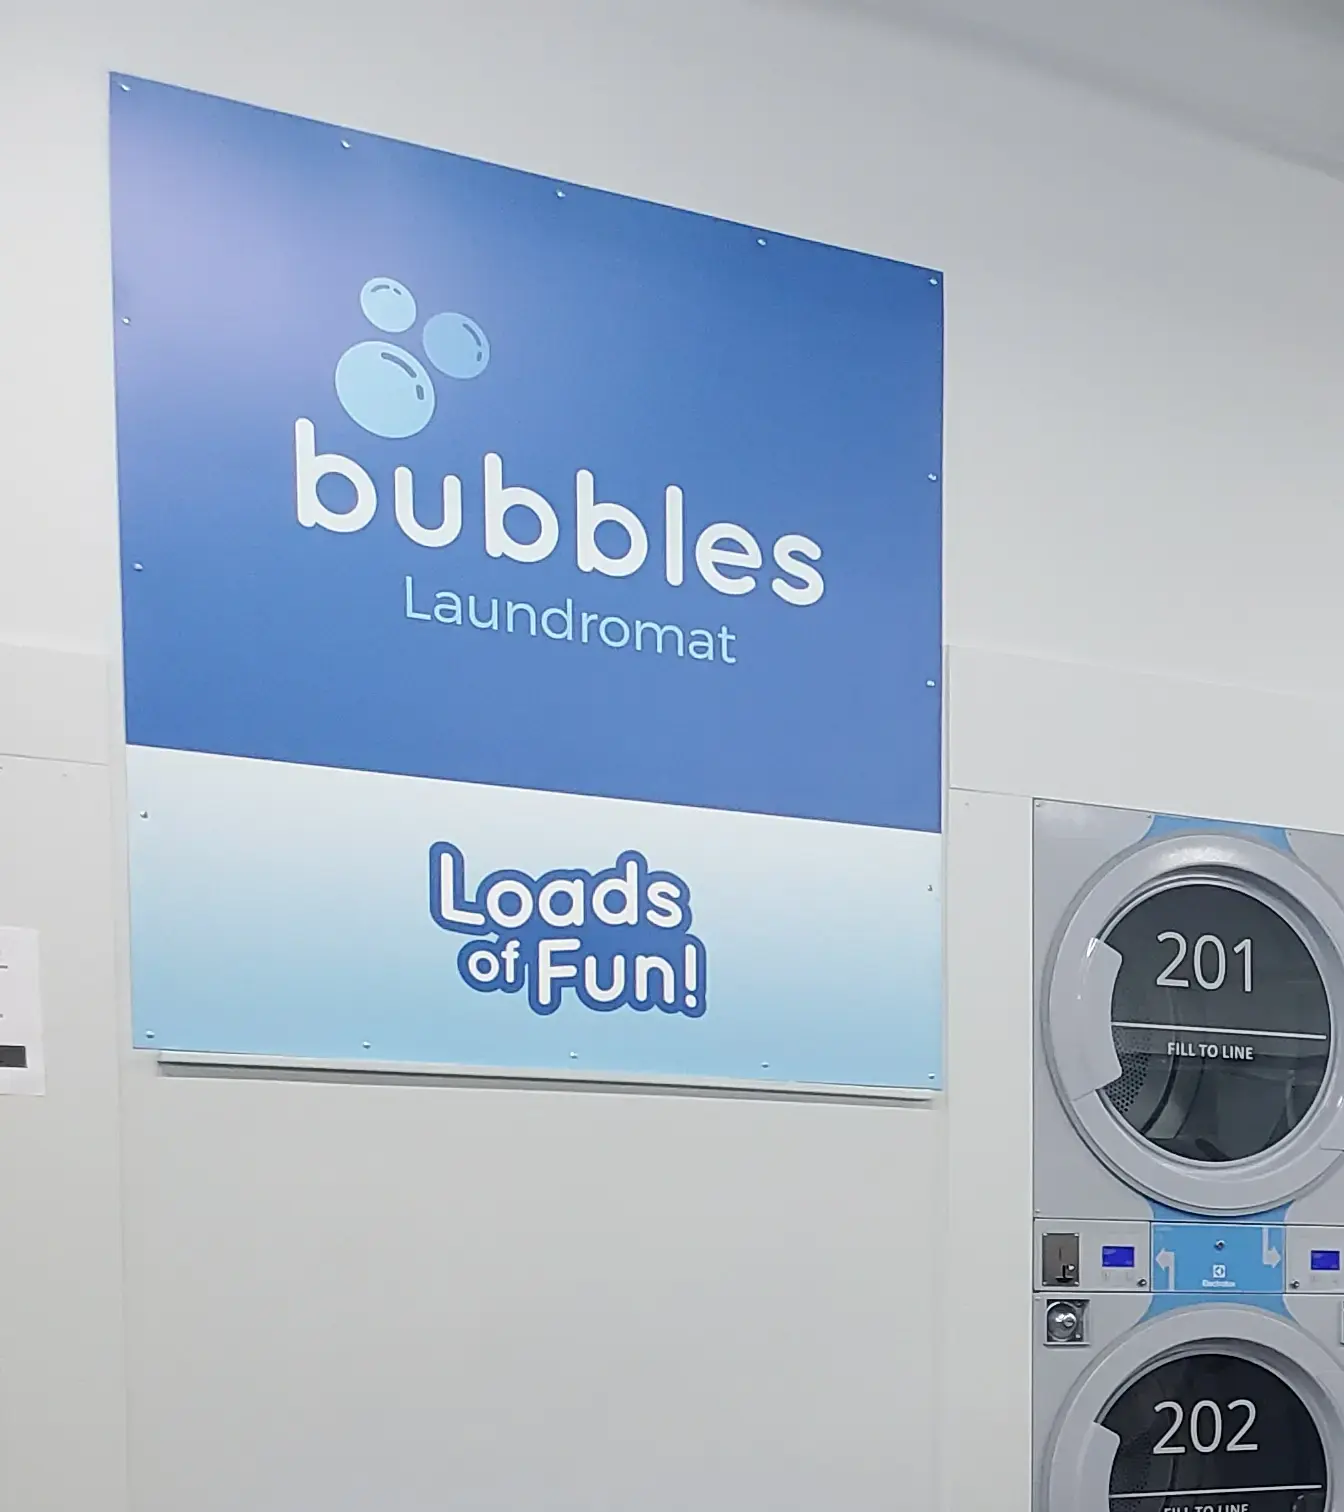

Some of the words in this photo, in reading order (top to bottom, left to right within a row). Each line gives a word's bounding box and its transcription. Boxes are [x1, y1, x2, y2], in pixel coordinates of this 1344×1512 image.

[294, 417, 825, 606] bubbles
[402, 575, 738, 664] Laundromat
[440, 851, 683, 929] Loads
[467, 940, 521, 983] of
[538, 938, 697, 1008] Fun!
[1156, 931, 1254, 993] 201
[1167, 1041, 1196, 1057] FILL
[1198, 1043, 1219, 1058] TO
[1222, 1045, 1254, 1060] LINE
[1152, 1399, 1259, 1455] 202
